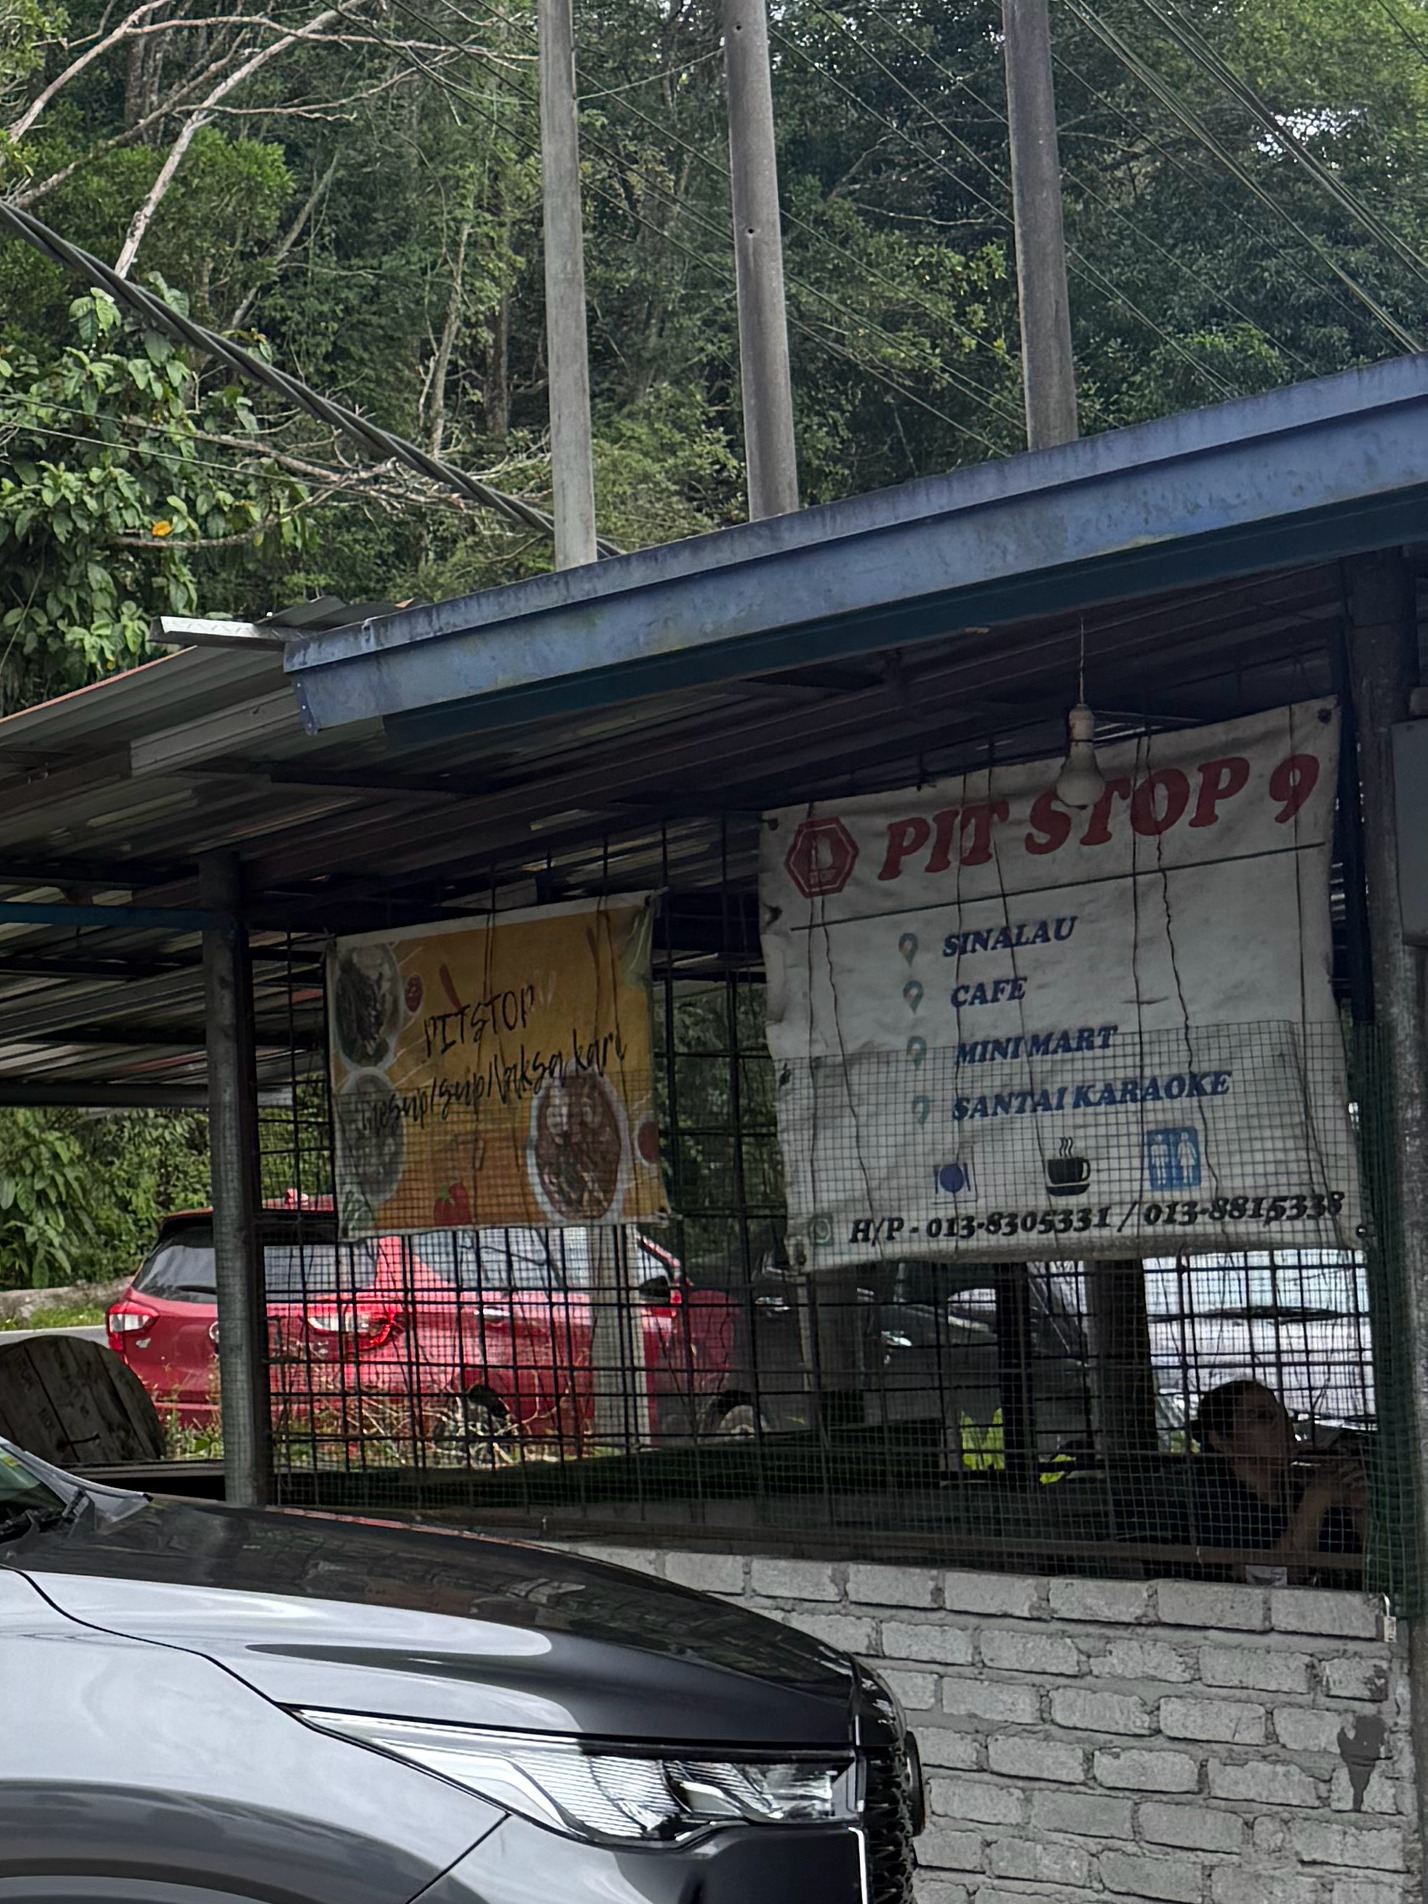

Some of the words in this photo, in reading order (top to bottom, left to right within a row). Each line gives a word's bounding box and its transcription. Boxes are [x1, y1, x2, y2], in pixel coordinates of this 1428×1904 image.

[877, 799, 1010, 881] PIT
[1024, 756, 1250, 855] STOP
[1268, 752, 1321, 824] 9
[942, 916, 1079, 957] SINALAU
[950, 976, 1028, 1009] CAFE
[952, 1087, 1066, 1121] SANTAI
[1072, 1070, 1234, 1109] KARAOKE
[926, 1205, 1112, 1239] 013-8305331
